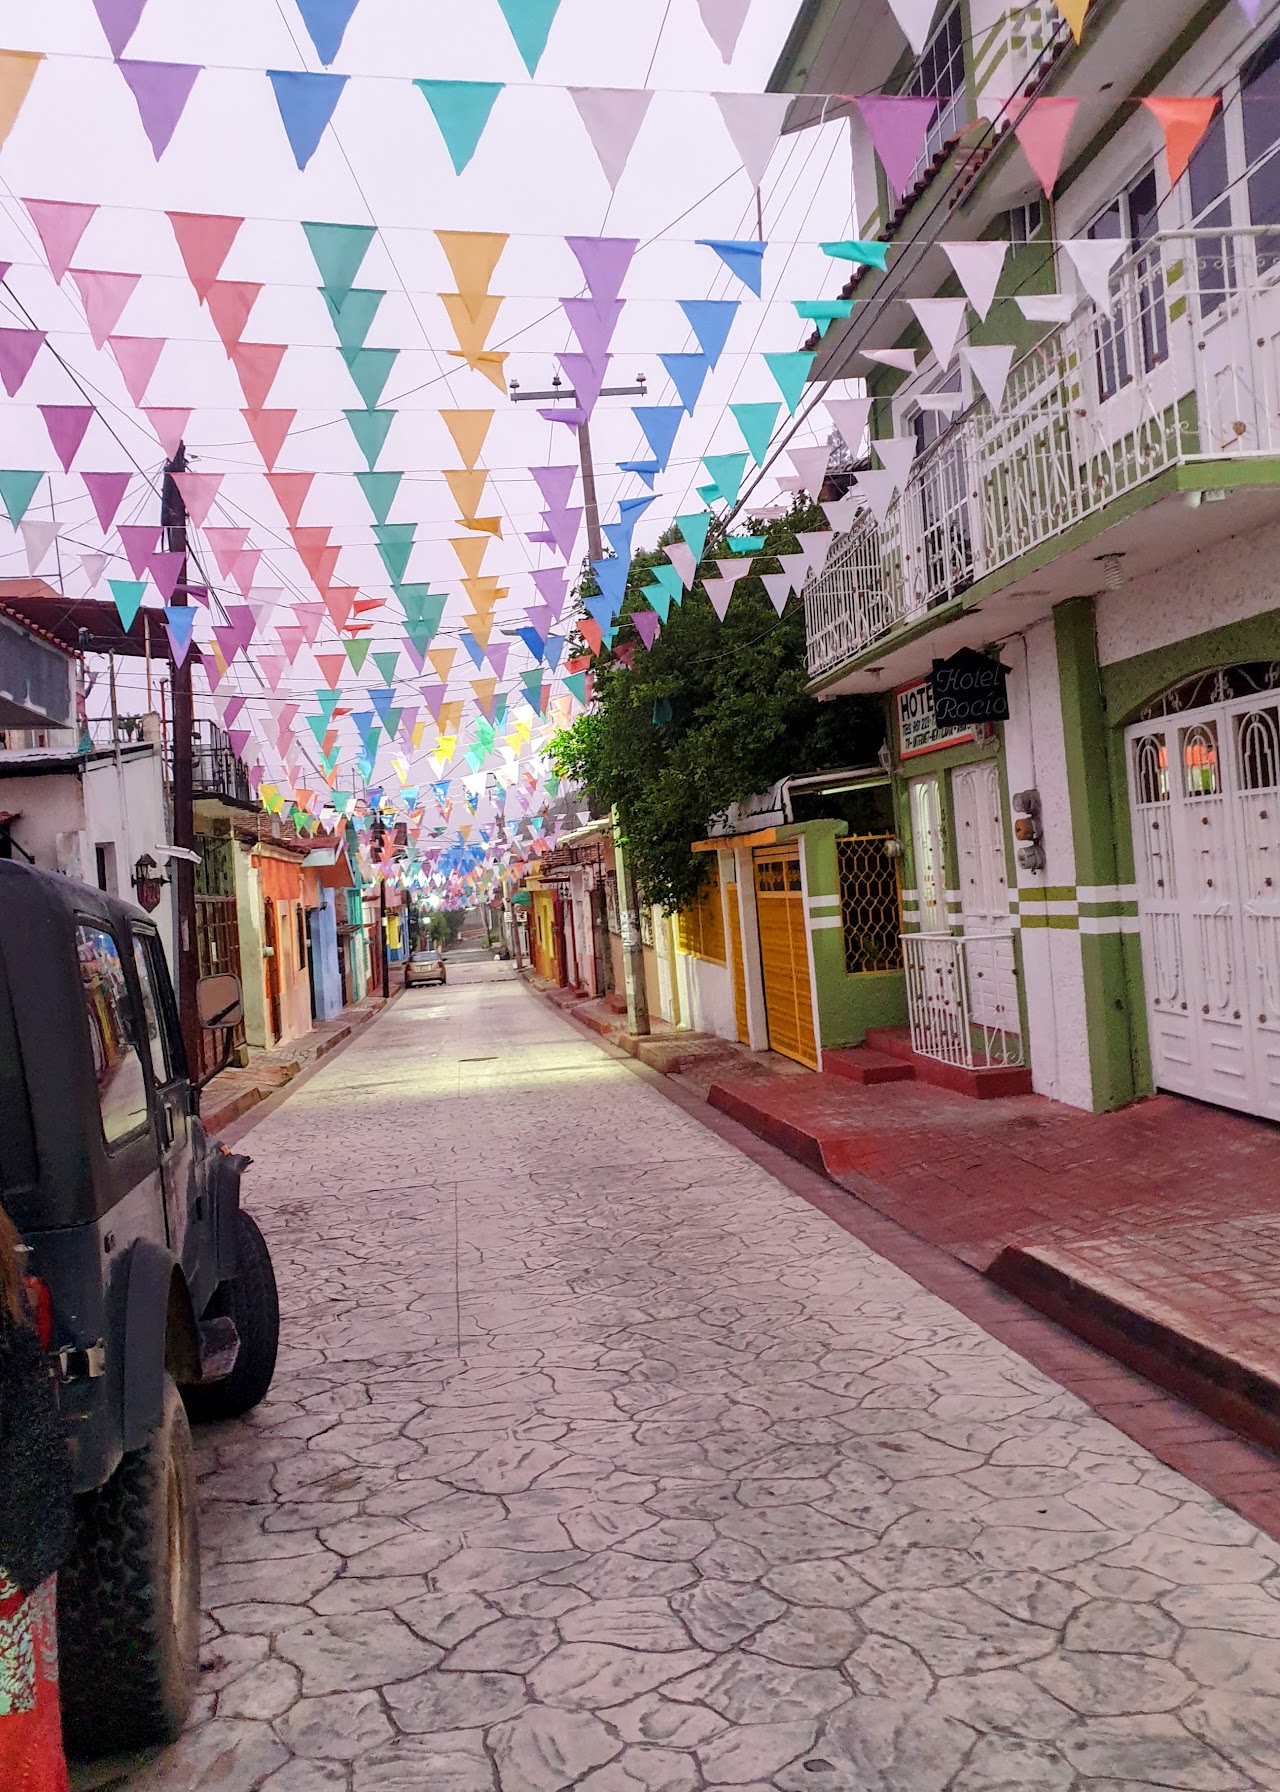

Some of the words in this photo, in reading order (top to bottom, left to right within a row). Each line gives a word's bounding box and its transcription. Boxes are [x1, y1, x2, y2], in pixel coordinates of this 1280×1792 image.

[936, 666, 1000, 692] Hotel
[900, 683, 934, 722] HOTE
[936, 691, 1007, 720] Rocío
